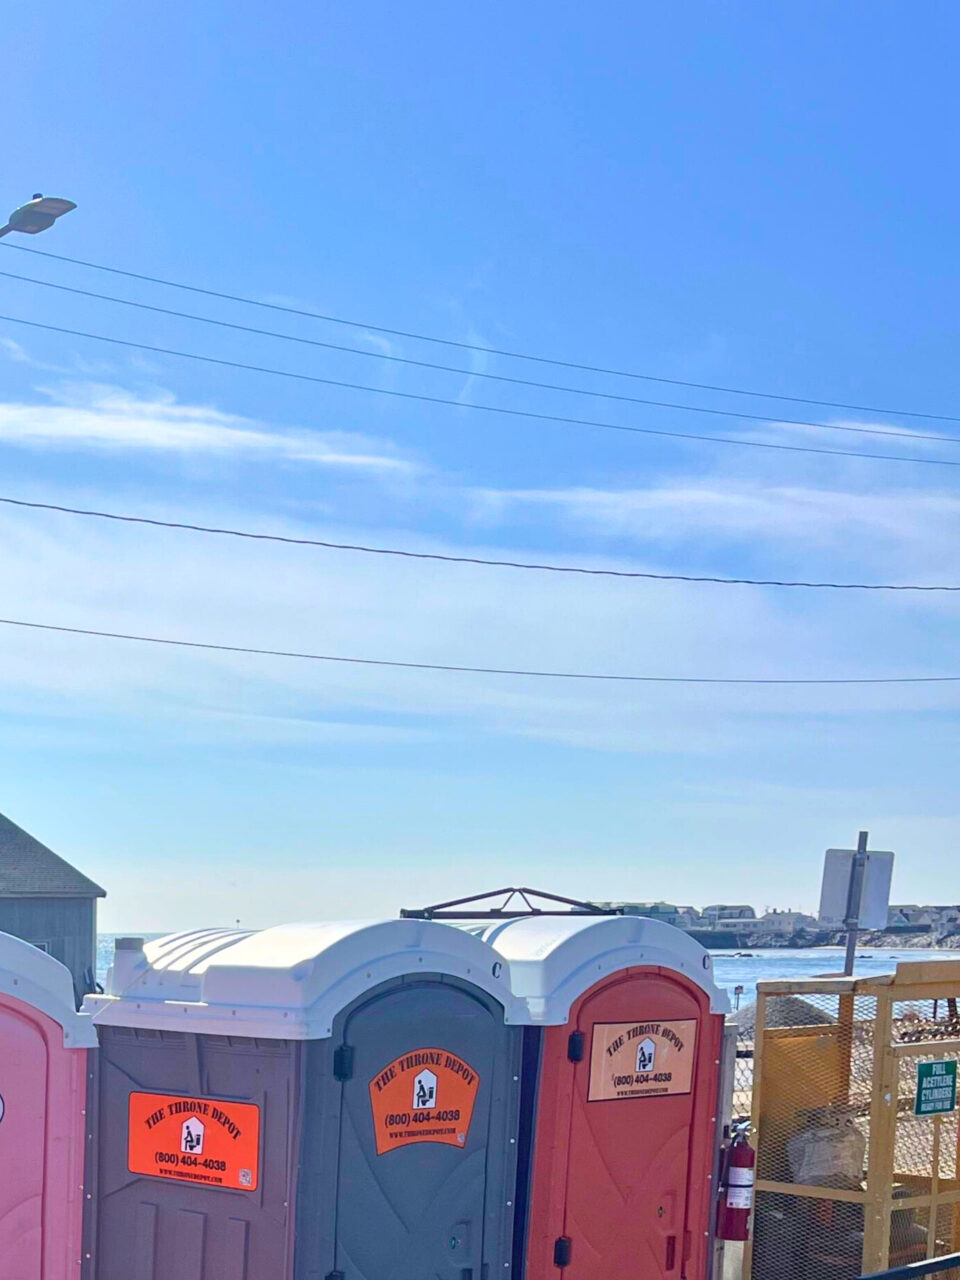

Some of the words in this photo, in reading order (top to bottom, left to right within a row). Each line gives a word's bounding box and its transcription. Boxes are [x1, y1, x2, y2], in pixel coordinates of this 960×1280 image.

[606, 1034, 625, 1057] THE
[626, 1023, 661, 1041] THRONE
[661, 1027, 685, 1053] DEPOT
[374, 1065, 398, 1092] THE
[399, 1052, 443, 1072] THRONE
[444, 1055, 476, 1086] DEPOT
[932, 1063, 946, 1075] FULL
[613, 1074, 634, 1089] (800)
[634, 1072, 673, 1085] 404-4038
[922, 1074, 954, 1088] ACETYLENE
[921, 1086, 952, 1101] CYLINDERS
[144, 1107, 166, 1130] THE
[168, 1101, 210, 1116] THRONE
[211, 1107, 242, 1140] DEPOT
[384, 1113, 411, 1128] (800)
[411, 1110, 460, 1124] 404-4038
[154, 1151, 180, 1167] (800)
[180, 1155, 227, 1172] 404-4038
